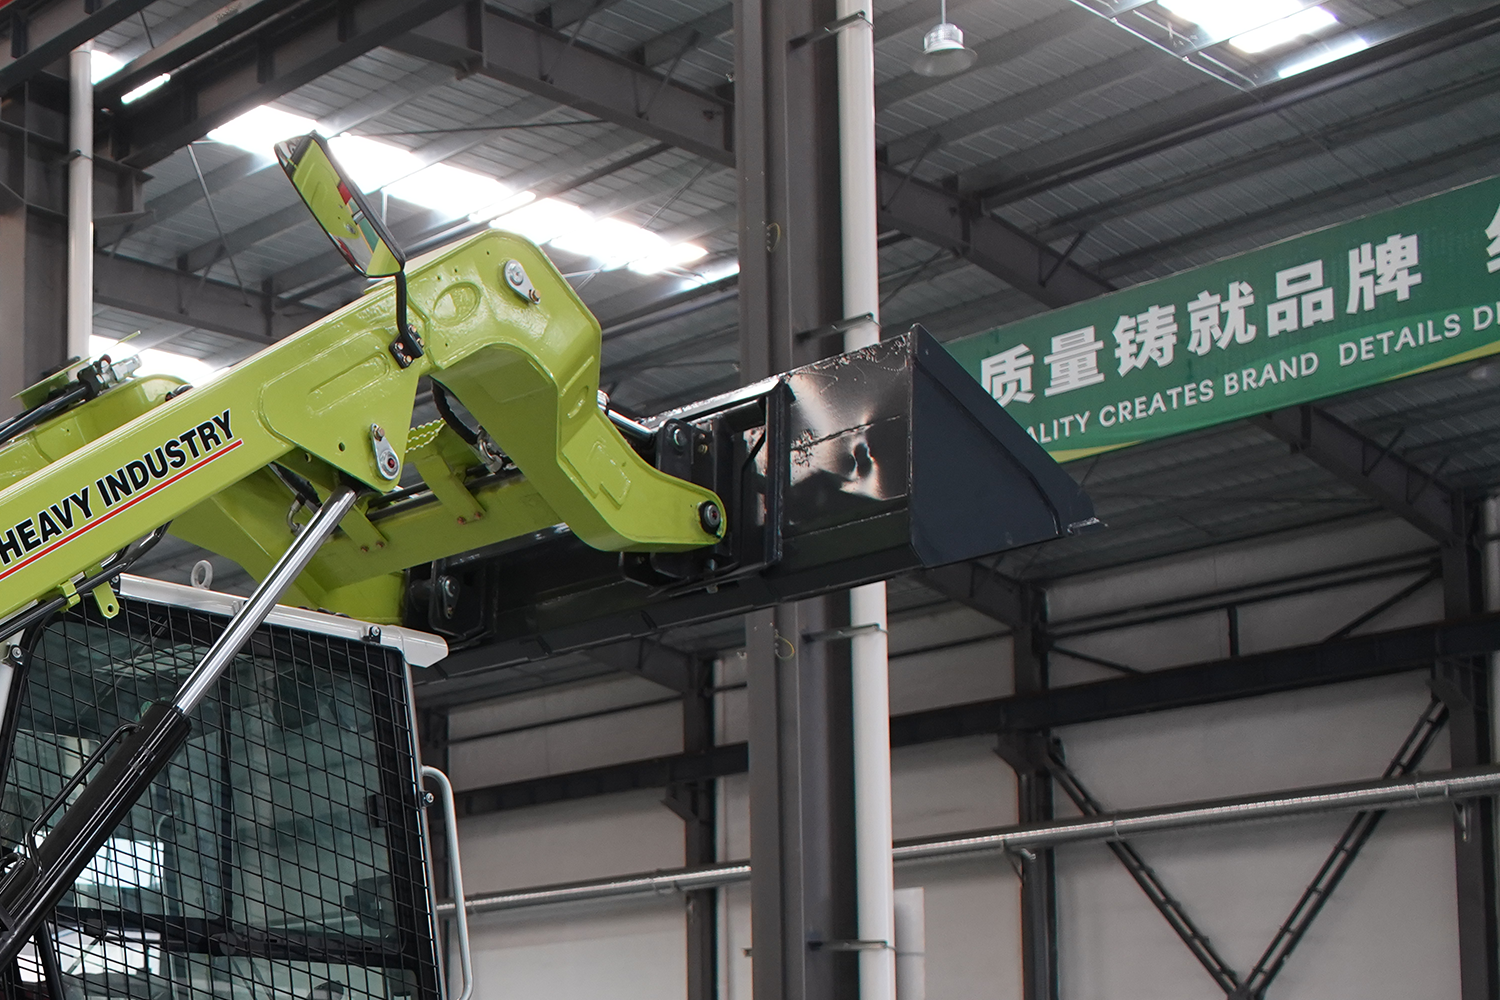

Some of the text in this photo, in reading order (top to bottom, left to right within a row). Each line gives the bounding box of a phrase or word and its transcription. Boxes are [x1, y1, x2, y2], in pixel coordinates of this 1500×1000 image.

[980, 233, 1422, 409] 质量铸就品牌
[1098, 380, 1214, 428] CREATES
[1224, 351, 1319, 397] BRAND
[1338, 313, 1462, 367] DETAILS
[1472, 301, 1500, 331] D
[95, 408, 234, 509] INDUSTRY
